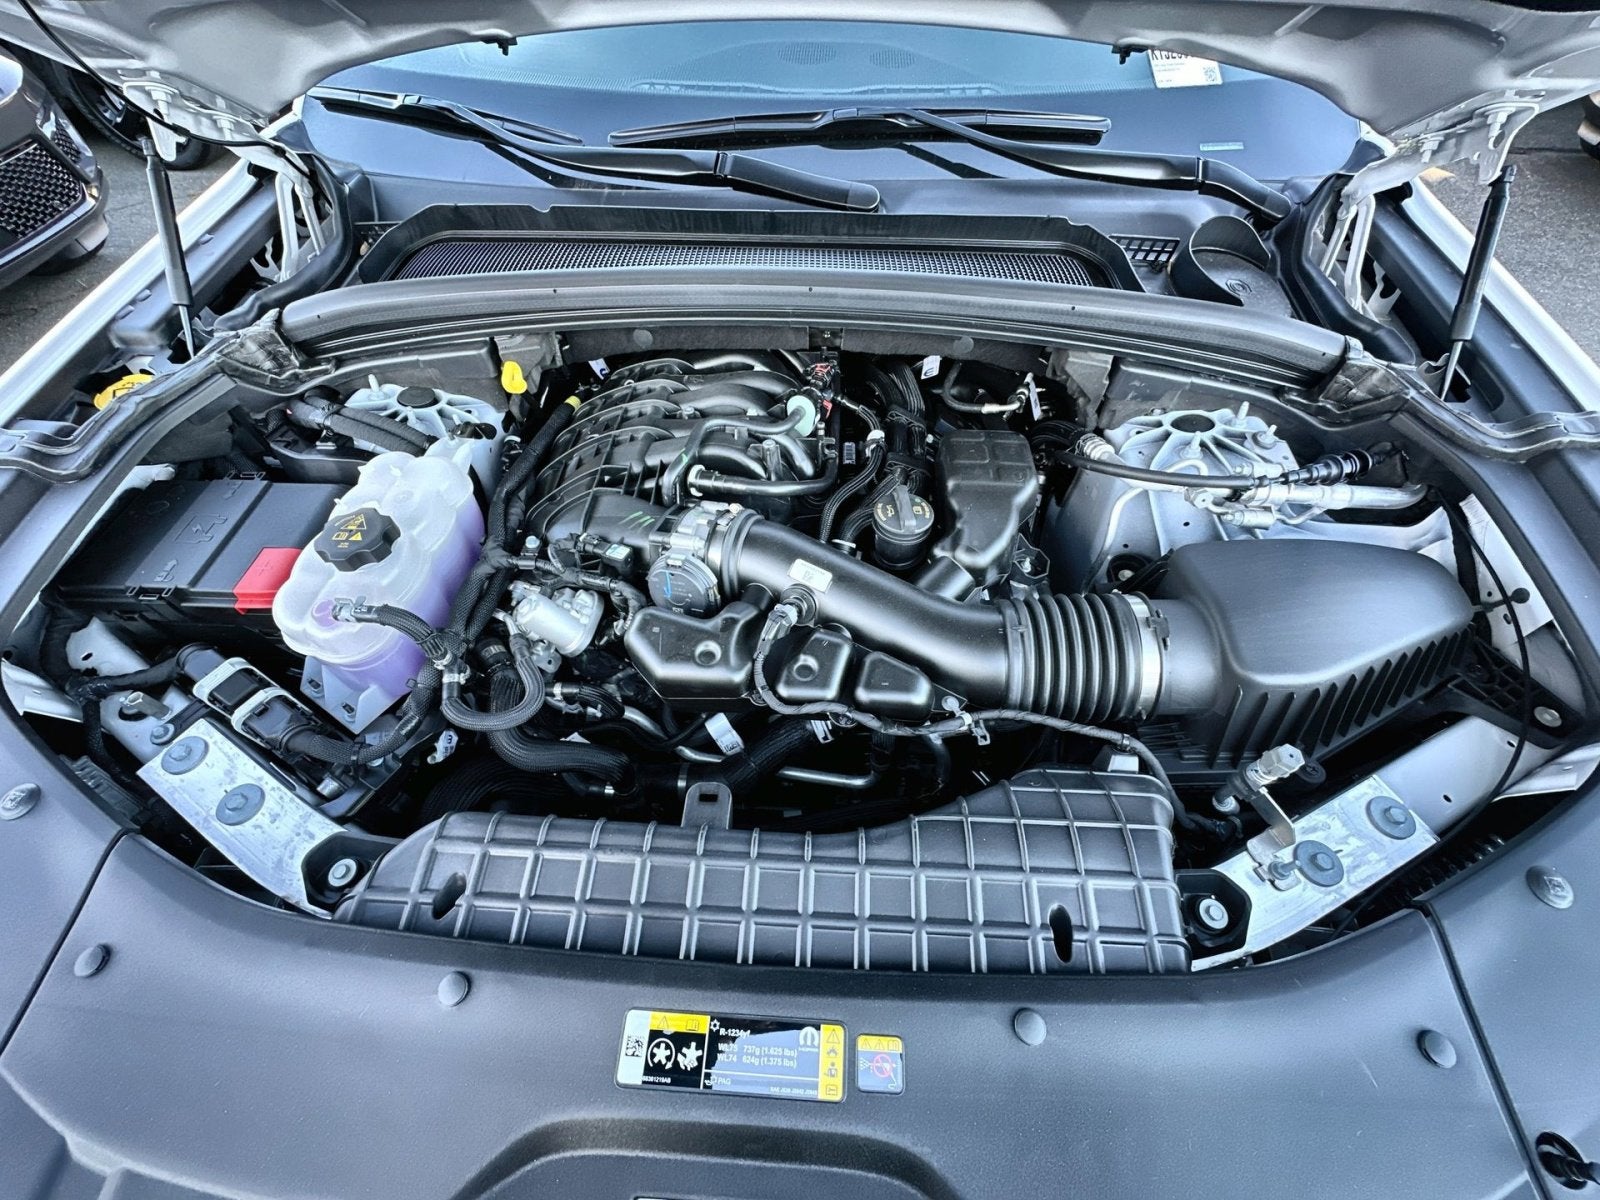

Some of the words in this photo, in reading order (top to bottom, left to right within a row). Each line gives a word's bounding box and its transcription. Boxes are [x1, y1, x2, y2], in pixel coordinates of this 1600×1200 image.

[720, 1028, 751, 1039] R-1234yf
[718, 1043, 738, 1052] WL75
[743, 1045, 760, 1056] 737g
[783, 1047, 798, 1058] lbs)
[717, 1053, 737, 1062] WL74
[742, 1055, 760, 1066] 624g
[760, 1056, 782, 1067] (1.375
[783, 1058, 797, 1069] lbs)
[718, 1077, 731, 1085] PAG
